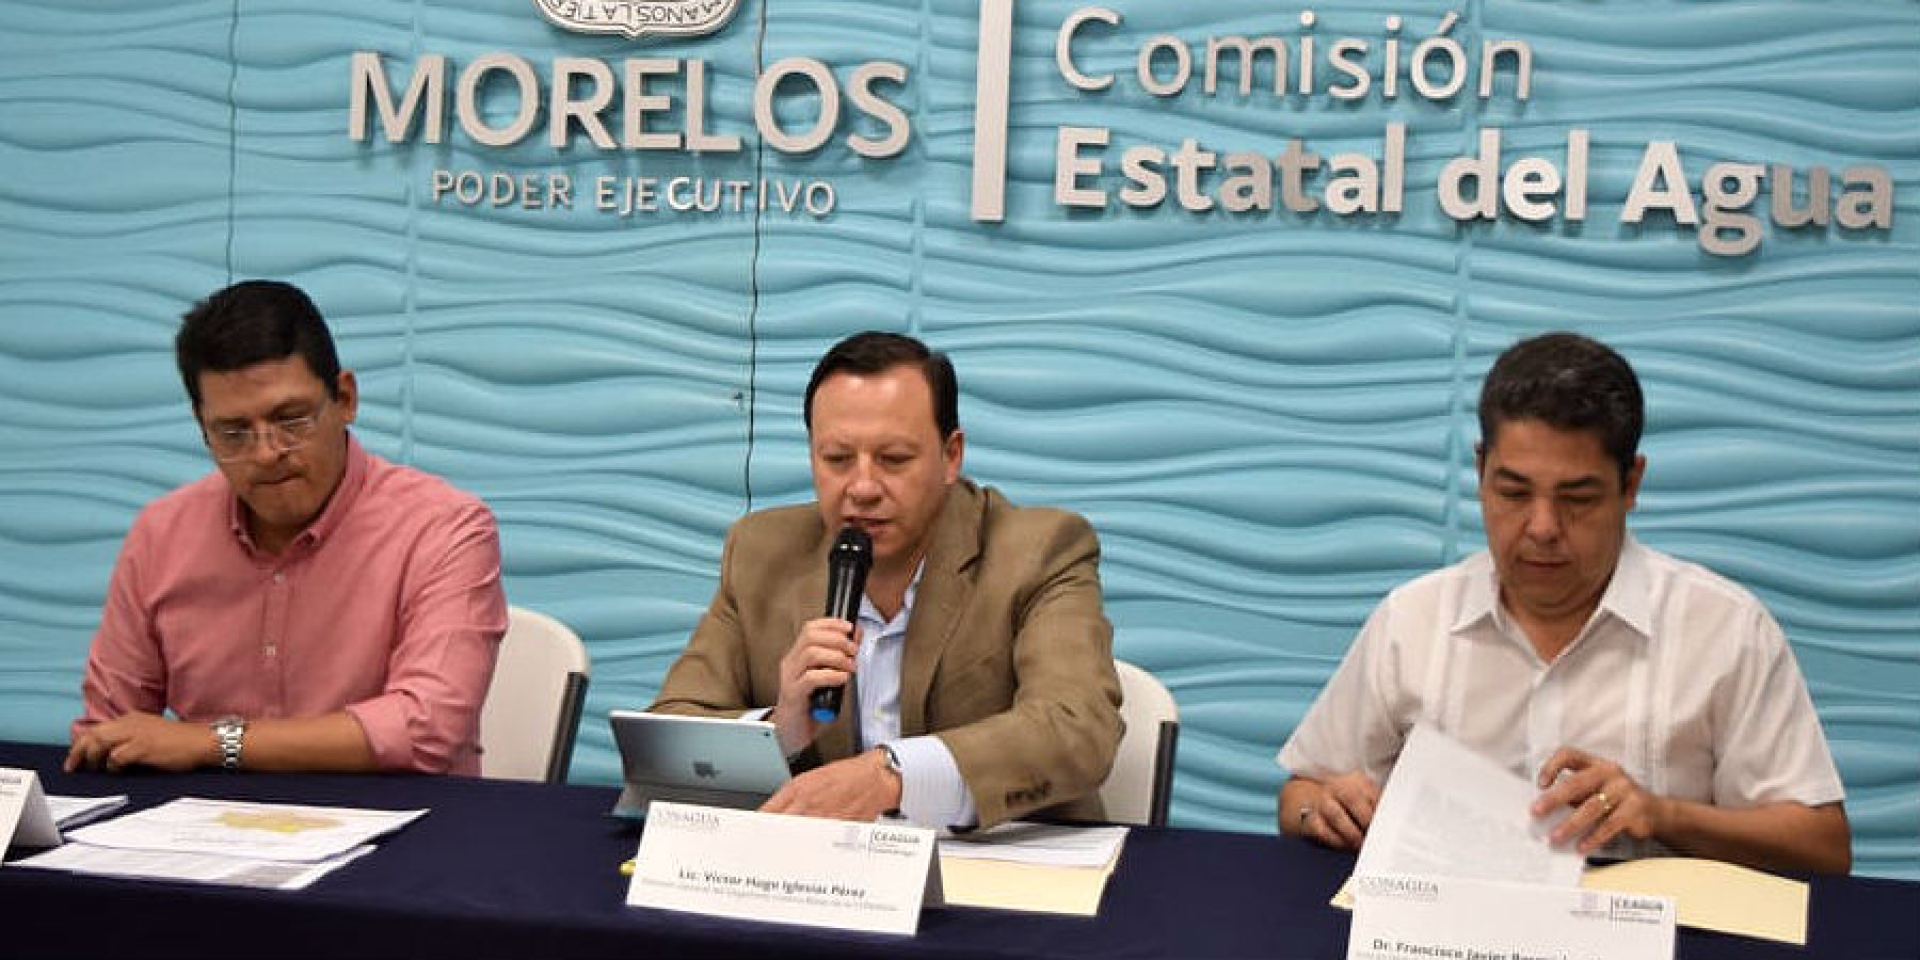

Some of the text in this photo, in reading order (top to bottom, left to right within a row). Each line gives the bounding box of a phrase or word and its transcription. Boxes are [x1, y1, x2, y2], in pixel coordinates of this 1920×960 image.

[1056, 6, 1533, 101] Comisión
[347, 51, 912, 159] MORELOS
[432, 170, 837, 217] PODER EJECUTIVO
[1055, 122, 1894, 257] Estatal del Agua
